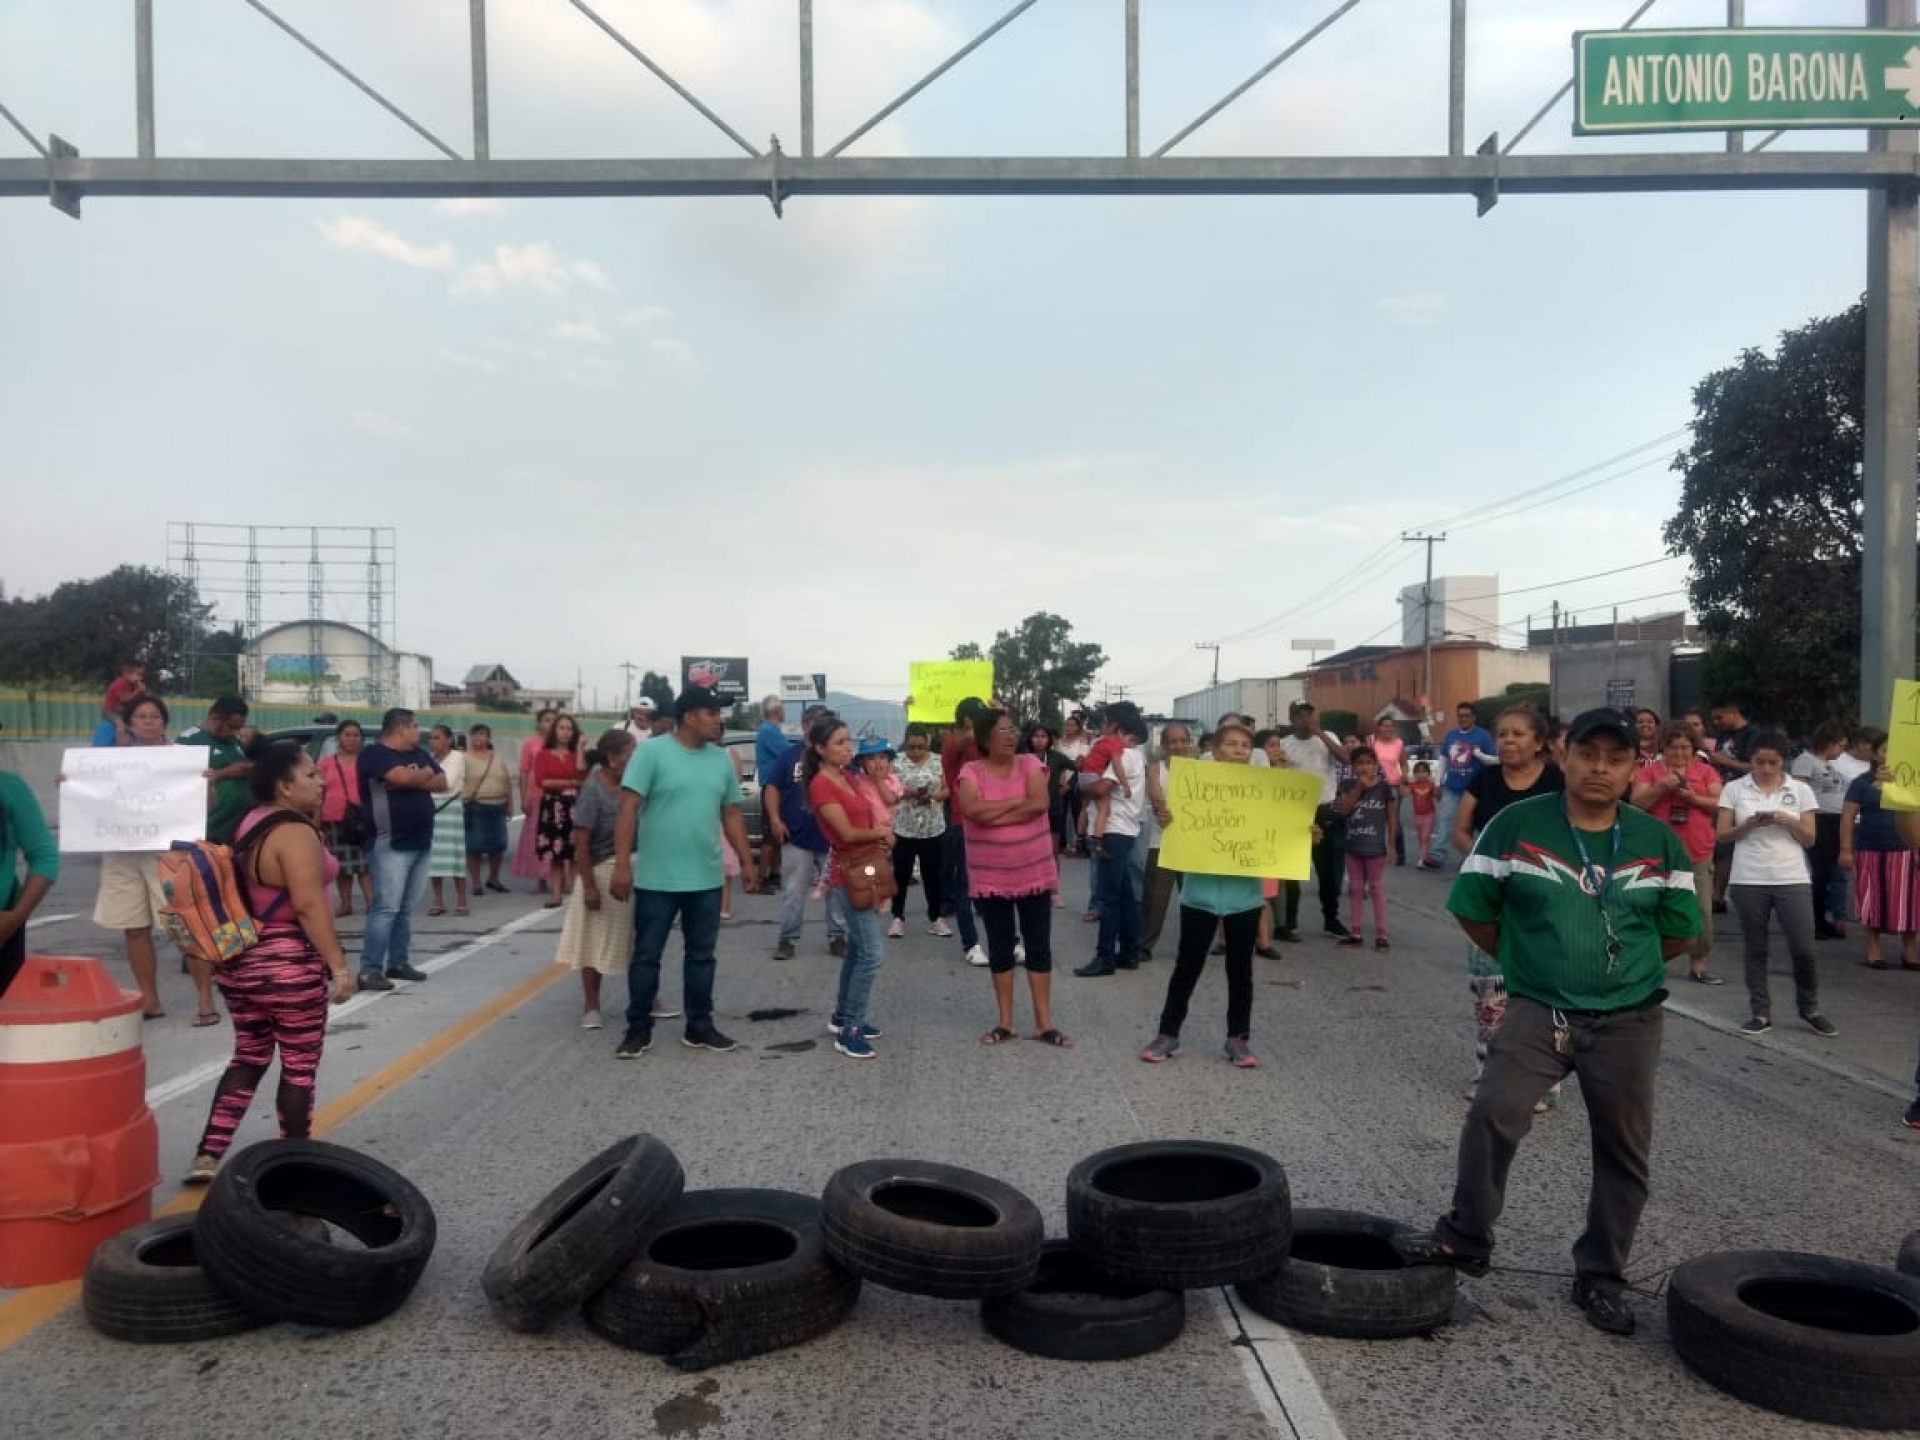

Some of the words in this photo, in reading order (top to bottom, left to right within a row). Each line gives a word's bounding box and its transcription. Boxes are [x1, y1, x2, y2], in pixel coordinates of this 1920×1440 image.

[1603, 53, 1732, 106] ANTONIO
[1747, 52, 1868, 102] BARONA
[1272, 784, 1307, 802] una
